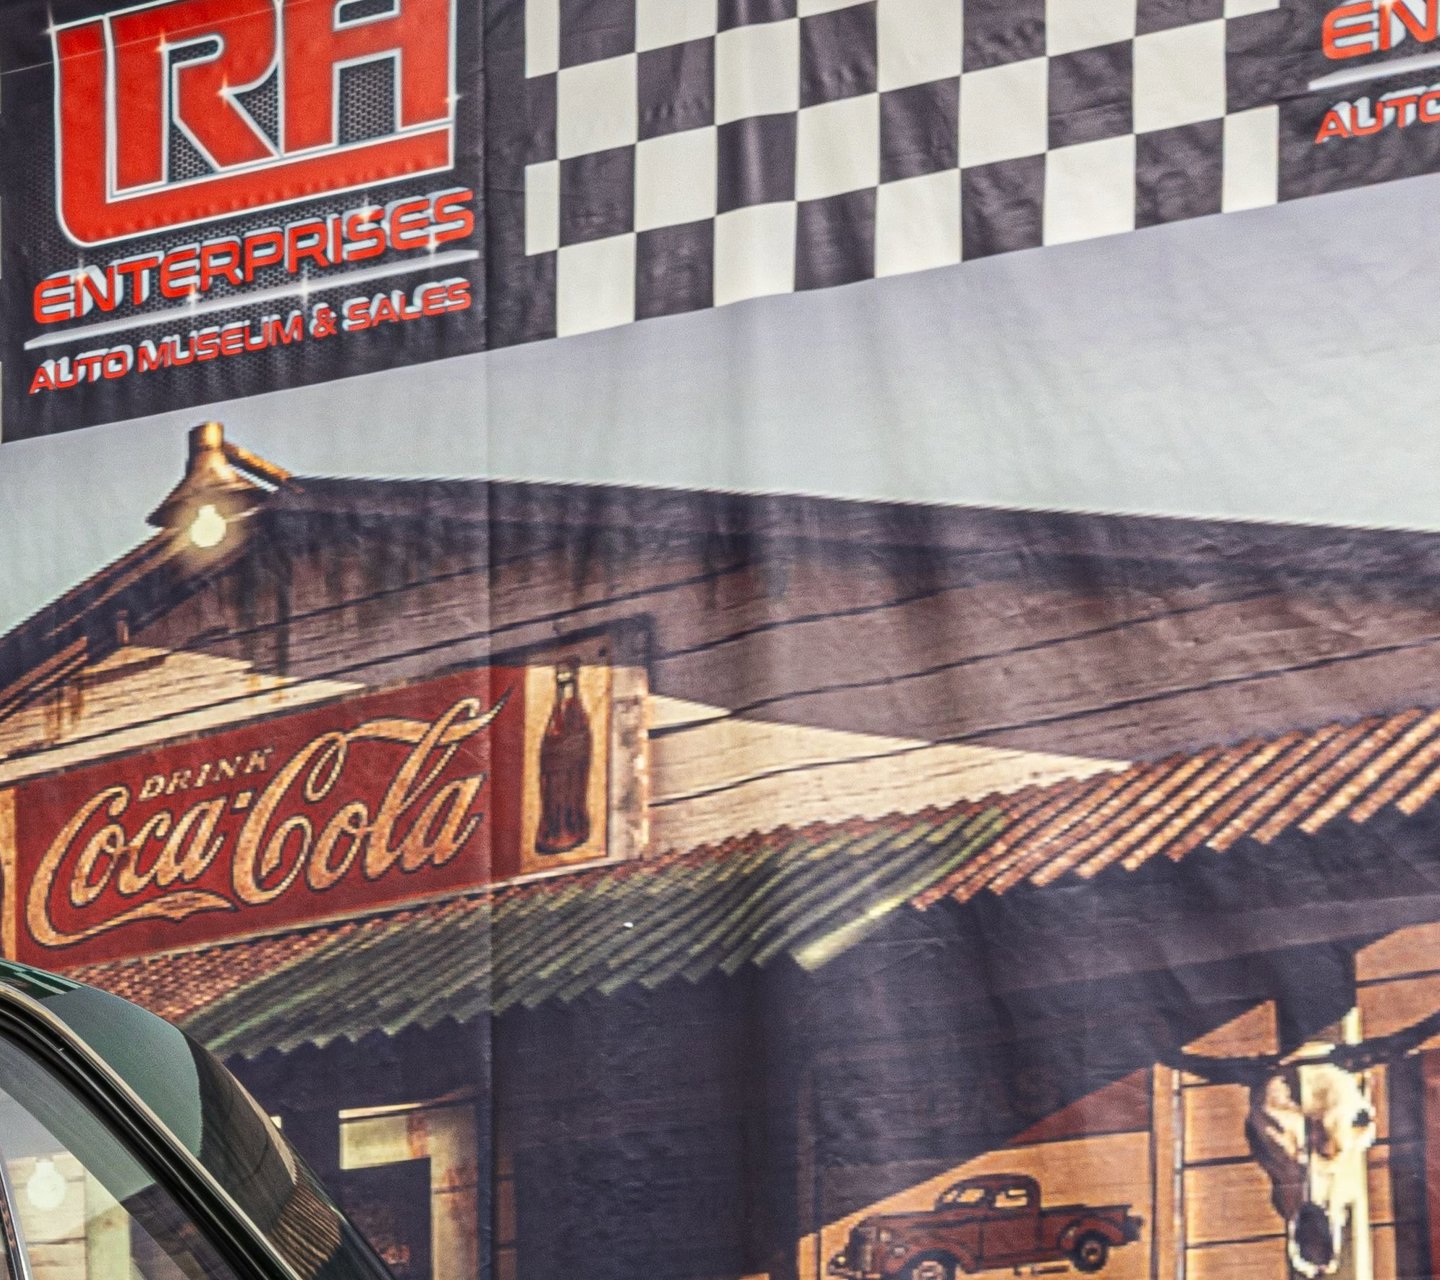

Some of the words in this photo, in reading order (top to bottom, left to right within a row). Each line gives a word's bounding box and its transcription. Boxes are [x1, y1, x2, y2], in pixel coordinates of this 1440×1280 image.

[32, 186, 476, 325] ENTERPRISES
[29, 342, 134, 396] AUTO
[138, 316, 304, 374] MUSEUM
[310, 307, 337, 339] &
[342, 276, 472, 334] SALES
[25, 684, 516, 947] Coca-Cola
[138, 745, 277, 802] DRINK
